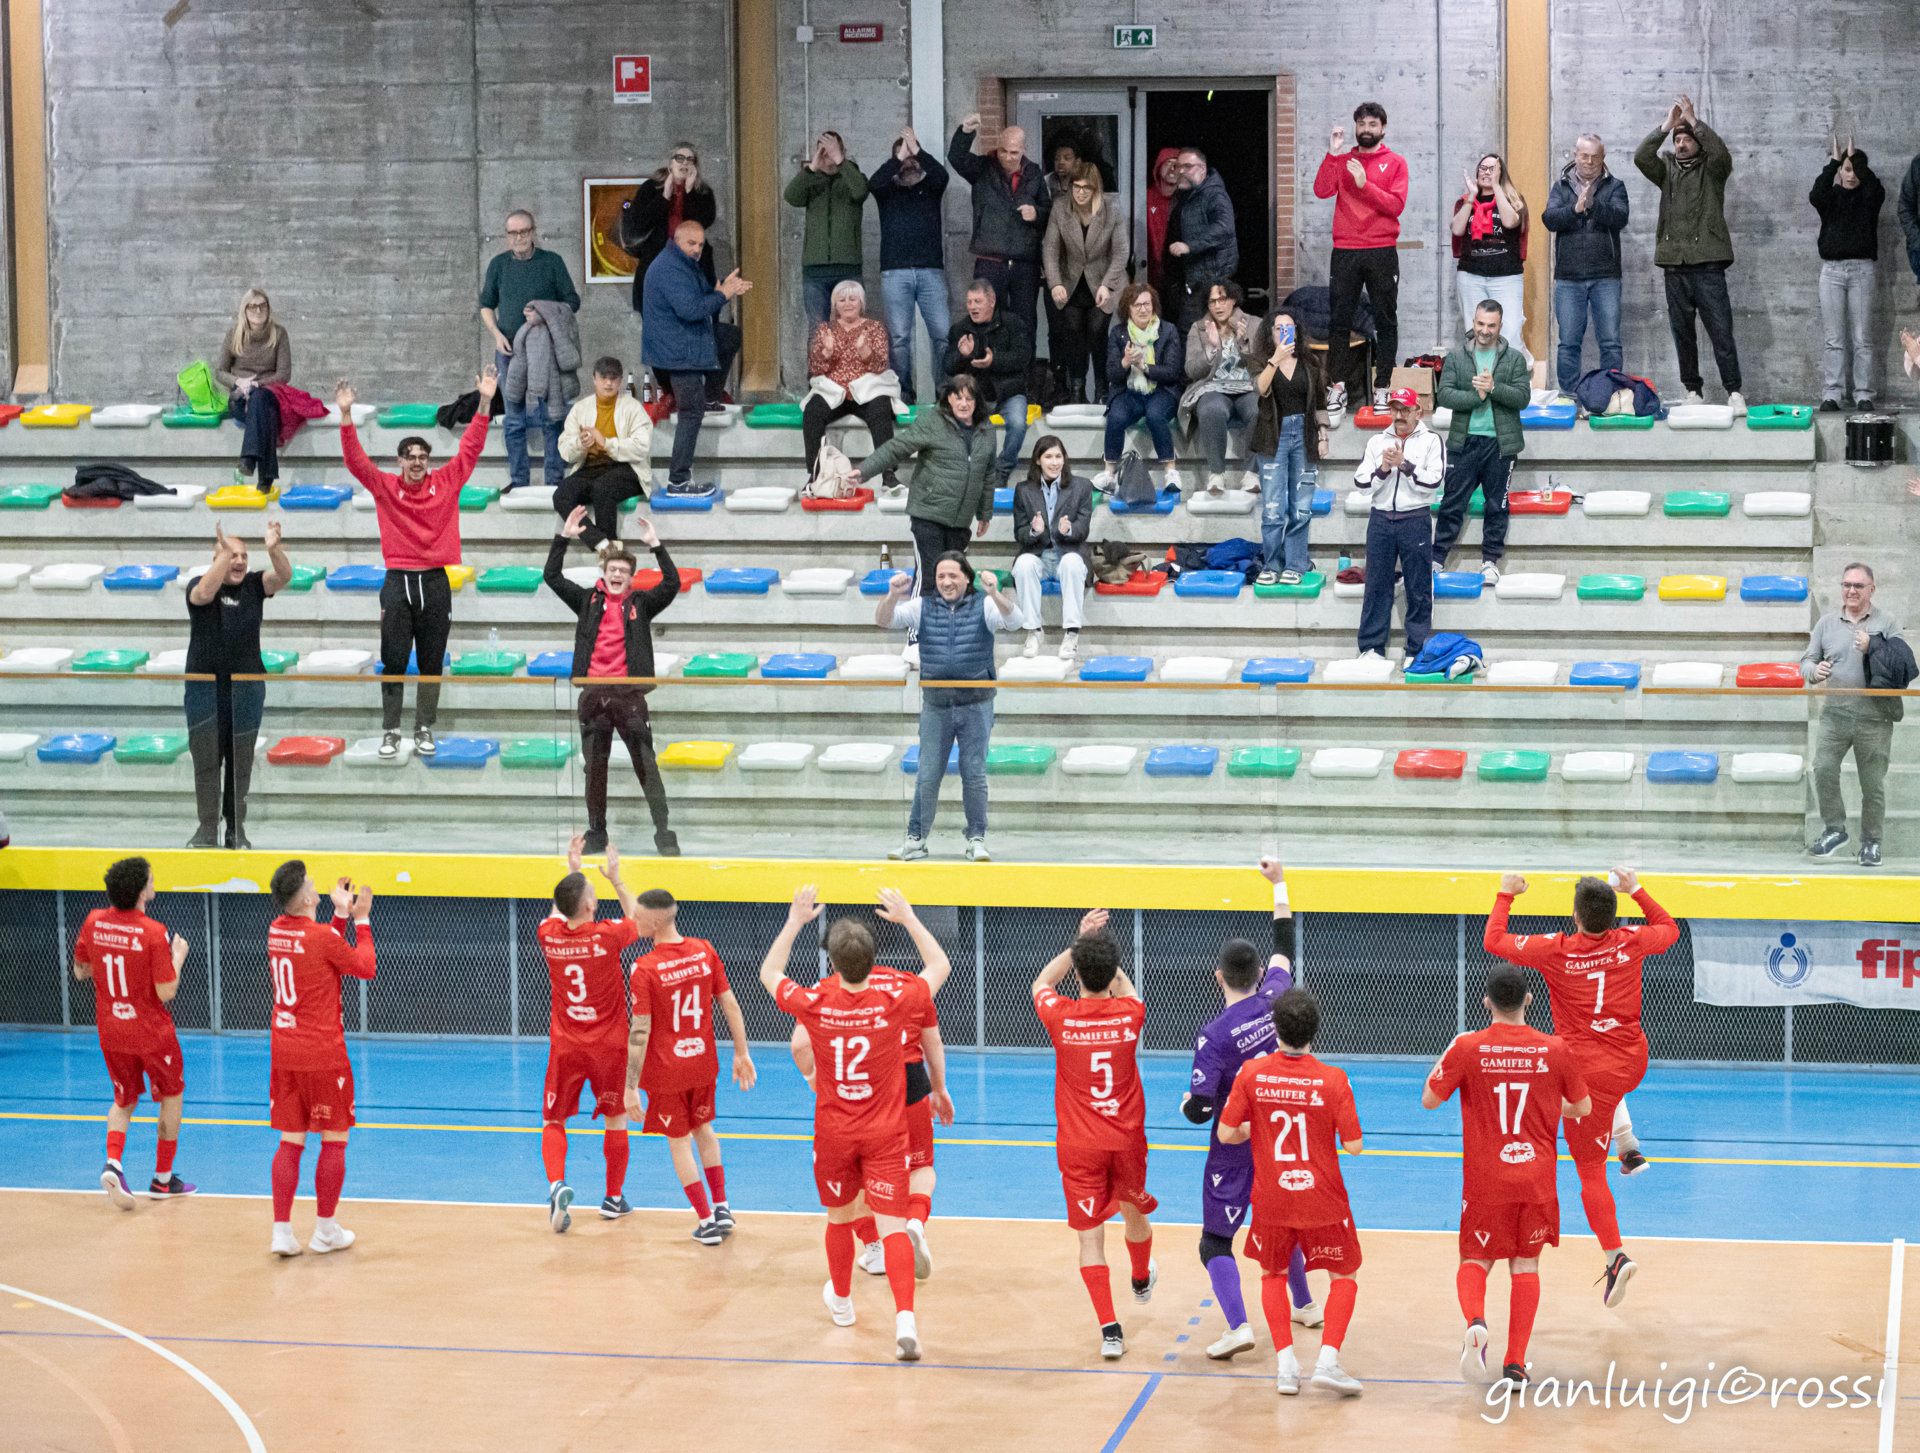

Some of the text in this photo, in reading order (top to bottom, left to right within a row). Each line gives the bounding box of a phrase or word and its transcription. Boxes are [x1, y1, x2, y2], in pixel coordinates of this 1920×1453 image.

[102, 953, 128, 997] 11
[271, 956, 297, 1006] 10
[564, 964, 587, 1003] 3
[660, 965, 701, 982] GAMIFER
[1586, 971, 1605, 1014] 7
[671, 985, 703, 1032] 14
[1230, 1013, 1272, 1037] SEPRIO
[1062, 1030, 1119, 1041] GAMIFER
[1479, 1045, 1537, 1053] SEPRIO
[830, 1035, 870, 1080] 12
[1090, 1051, 1113, 1099] 5
[1480, 1057, 1533, 1068] GAMIFER
[1256, 1074, 1311, 1086] SEPRIO
[1256, 1087, 1306, 1100] GAMIFER
[1493, 1083, 1530, 1134] 17
[1270, 1110, 1309, 1161] 21
